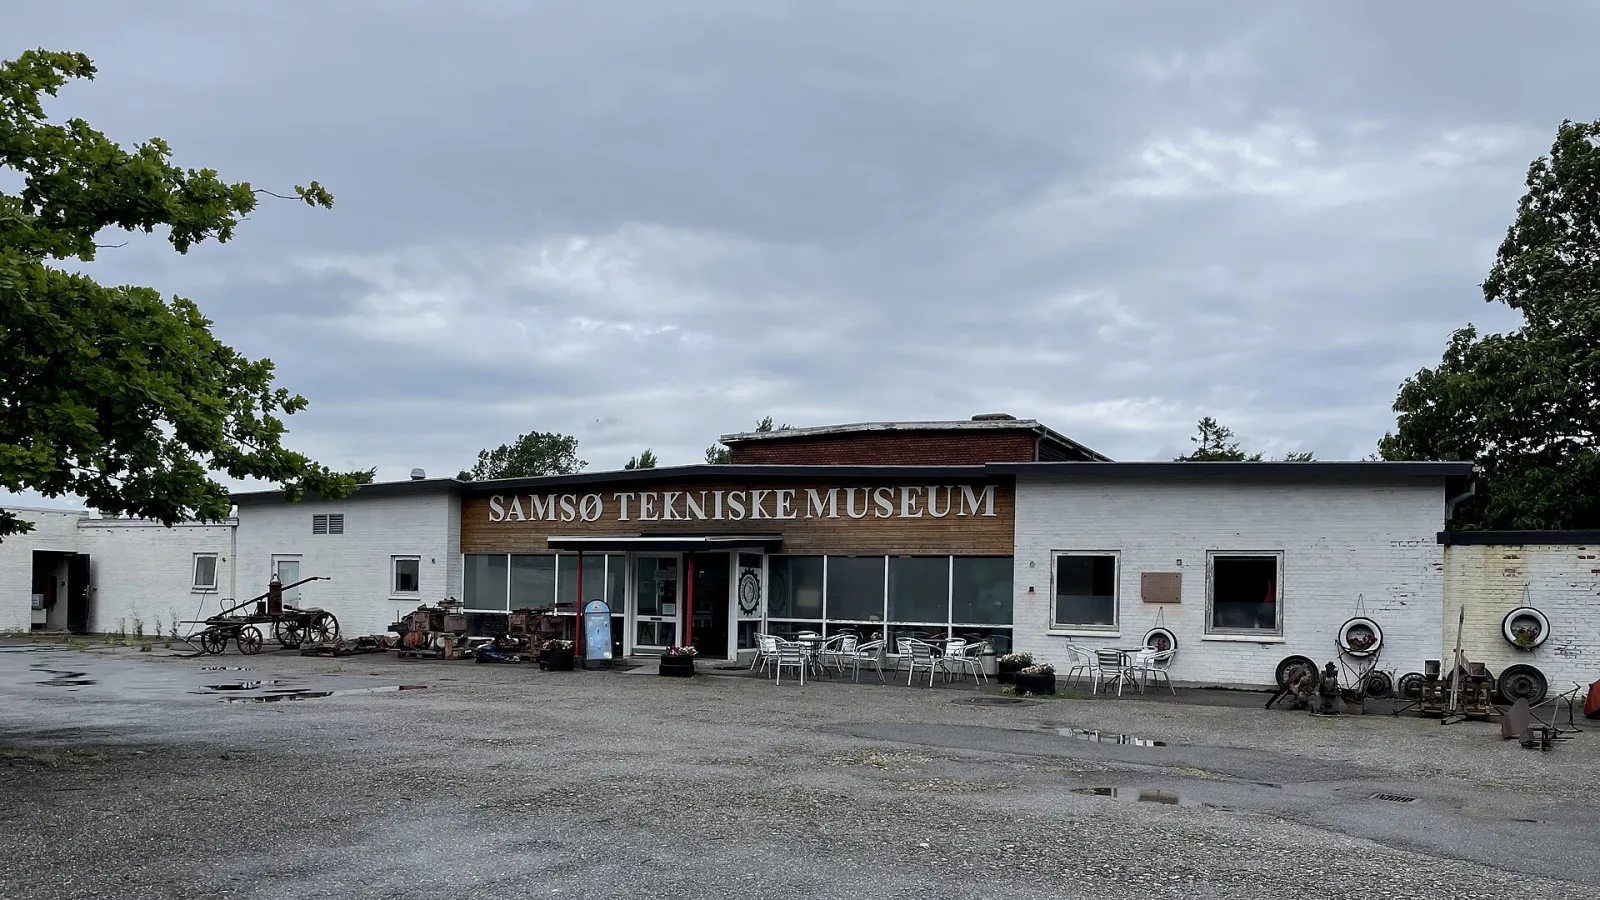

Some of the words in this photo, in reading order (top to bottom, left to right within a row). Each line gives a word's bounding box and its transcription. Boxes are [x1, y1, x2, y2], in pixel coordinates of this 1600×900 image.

[488, 494, 604, 523] SAMSØ
[613, 489, 797, 522] TEKNISKE
[804, 484, 998, 519] MUSEUM
